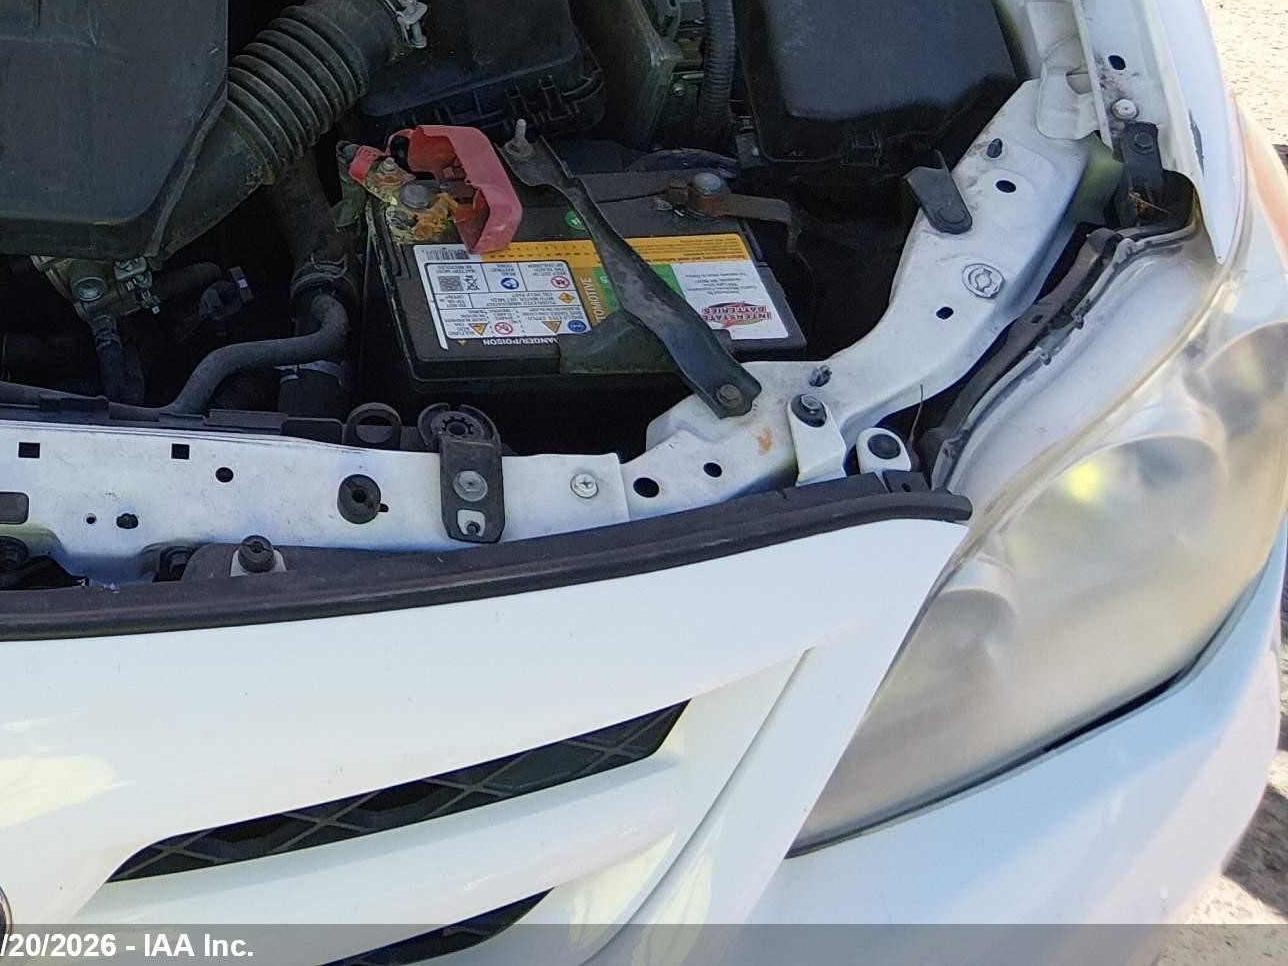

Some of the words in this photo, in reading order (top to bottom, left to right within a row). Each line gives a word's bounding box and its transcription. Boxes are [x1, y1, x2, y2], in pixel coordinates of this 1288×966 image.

[580, 277, 606, 323] TOMOTIVE
[702, 305, 767, 315] BATTERIES
[703, 313, 772, 323] INTERSTATE
